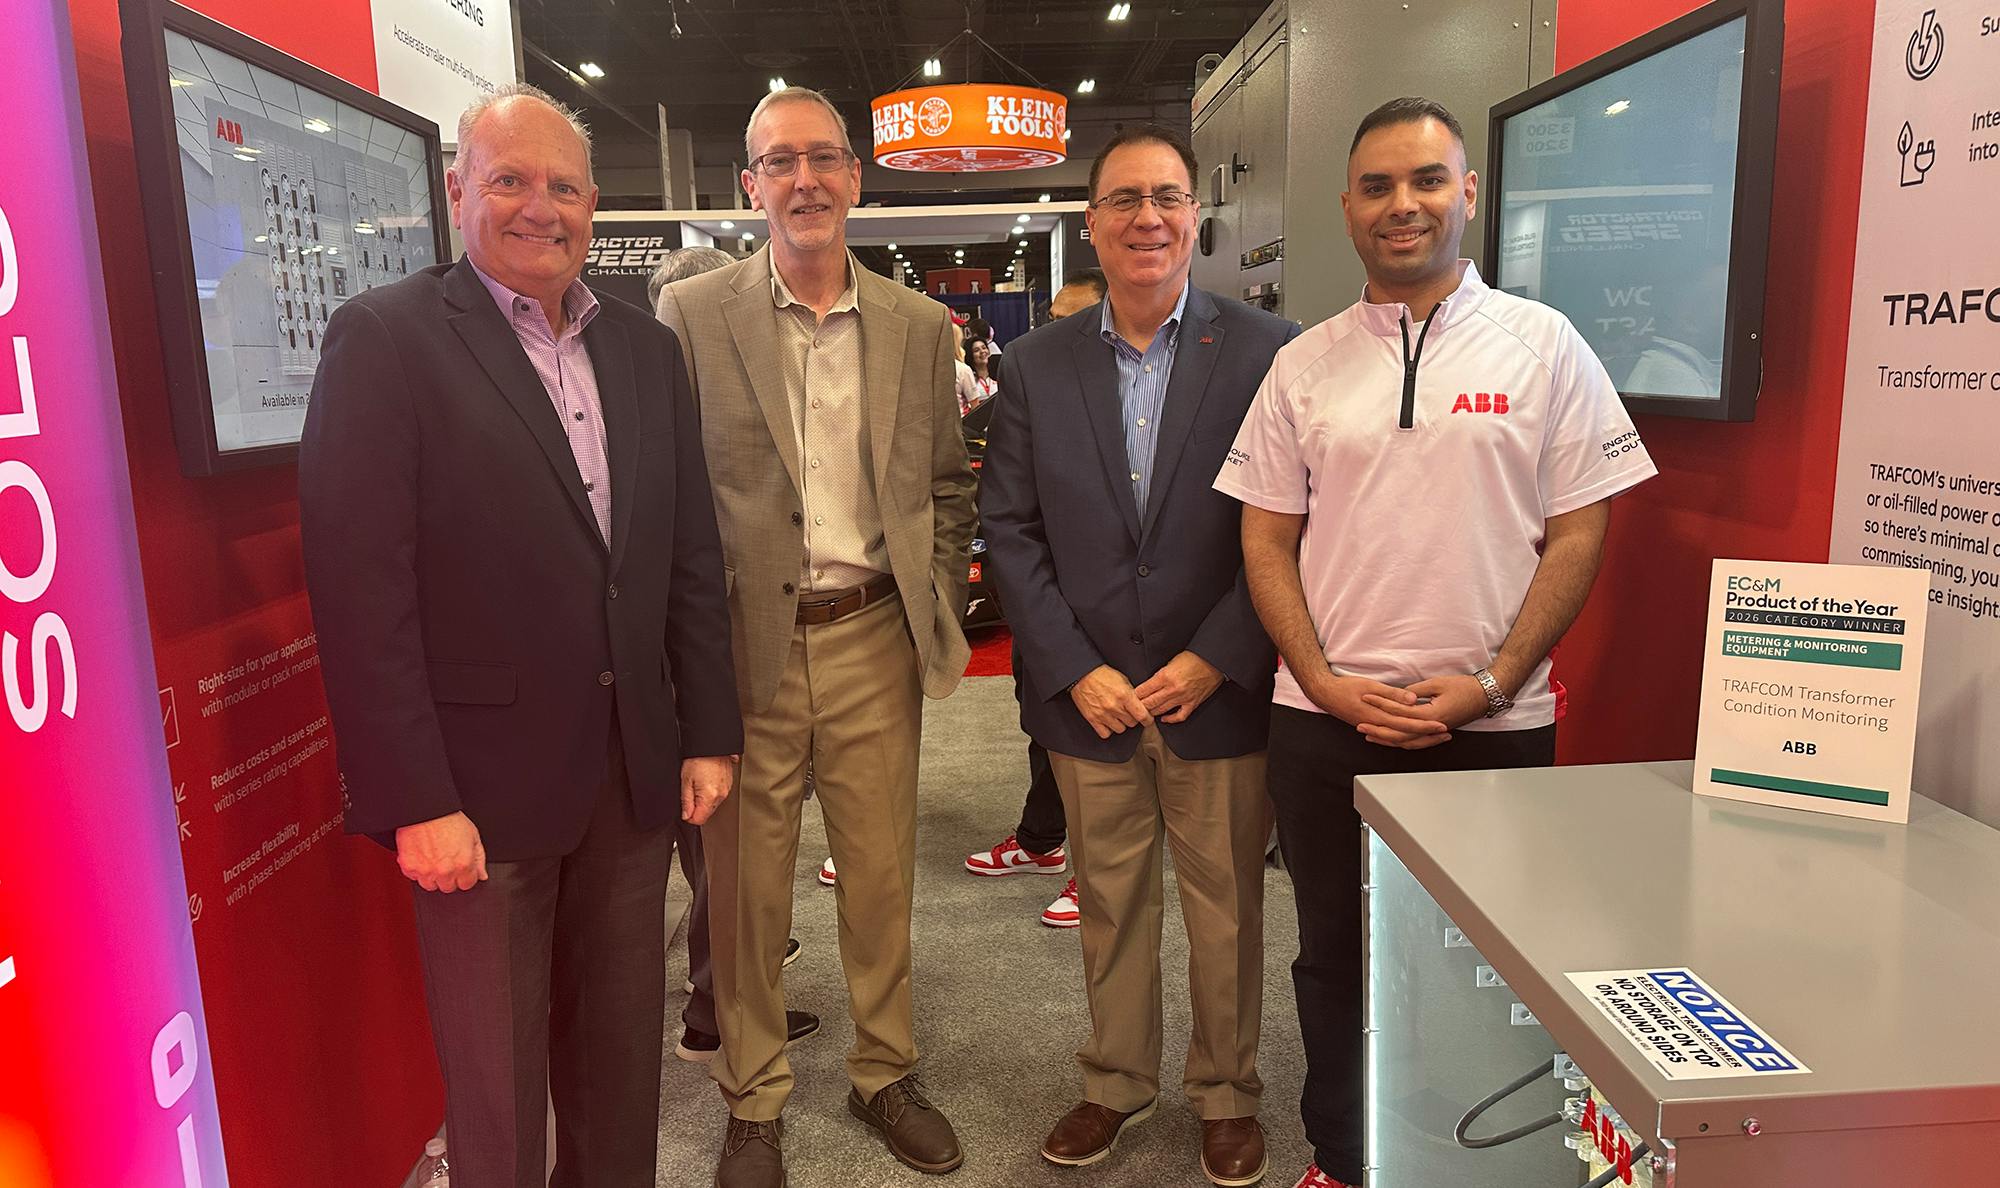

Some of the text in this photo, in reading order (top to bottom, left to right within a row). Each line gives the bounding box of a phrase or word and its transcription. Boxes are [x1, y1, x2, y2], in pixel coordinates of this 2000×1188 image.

[393, 24, 425, 55] Accelerate
[987, 96, 1053, 121] KLEIN
[217, 117, 243, 145] ABB
[987, 115, 1053, 139] TOOLS
[1969, 143, 1998, 162] into
[1878, 364, 1987, 390] Transformer
[262, 393, 297, 408] Available
[297, 393, 305, 405] in
[1451, 393, 1509, 414] ABB
[1605, 451, 1620, 461] TO
[1867, 493, 1881, 507] or
[1883, 492, 1938, 516] oil-filled
[1940, 504, 1988, 525] power
[1864, 519, 1879, 534] so
[1930, 529, 1990, 555] minimal
[1728, 576, 1781, 592] EC&M
[1726, 591, 1899, 617] Product of the Year
[1947, 588, 2000, 618] insight
[1729, 611, 1902, 633] 2026 CATEGORY WINNER
[1726, 643, 1790, 657] EQUIPMENT
[1727, 634, 1868, 654] METERING & MONITORING
[198, 663, 245, 694] Right-size
[245, 658, 260, 674] for
[260, 649, 280, 671] your
[201, 698, 223, 718] with
[224, 680, 260, 708] modular
[261, 676, 271, 690] or
[271, 667, 291, 689] pack
[1722, 678, 1896, 708] TRAFCOM Transformer
[1723, 698, 1889, 732] Condition Monitoring
[210, 715, 329, 790] Reduce costs and save space
[1782, 740, 1817, 755] ABB
[213, 736, 330, 813] with series rating capabilities
[223, 821, 301, 884] Increase flexibility
[226, 882, 247, 906] with
[247, 863, 274, 895] phase
[273, 836, 311, 872] balancing
[311, 829, 320, 844] at
[320, 820, 333, 836] the
[1595, 984, 1689, 1064] OR AROUND SIDES
[1613, 978, 1635, 991] NO
[1628, 991, 1683, 1032] STORAGE
[1671, 1029, 1697, 1047] ON
[1690, 1047, 1721, 1069] TOP
[1636, 976, 1743, 1068] ELECTRICAL TRANSFORMER
[1656, 974, 1789, 1068] NOTICE
[1581, 1097, 1632, 1186] ABB
